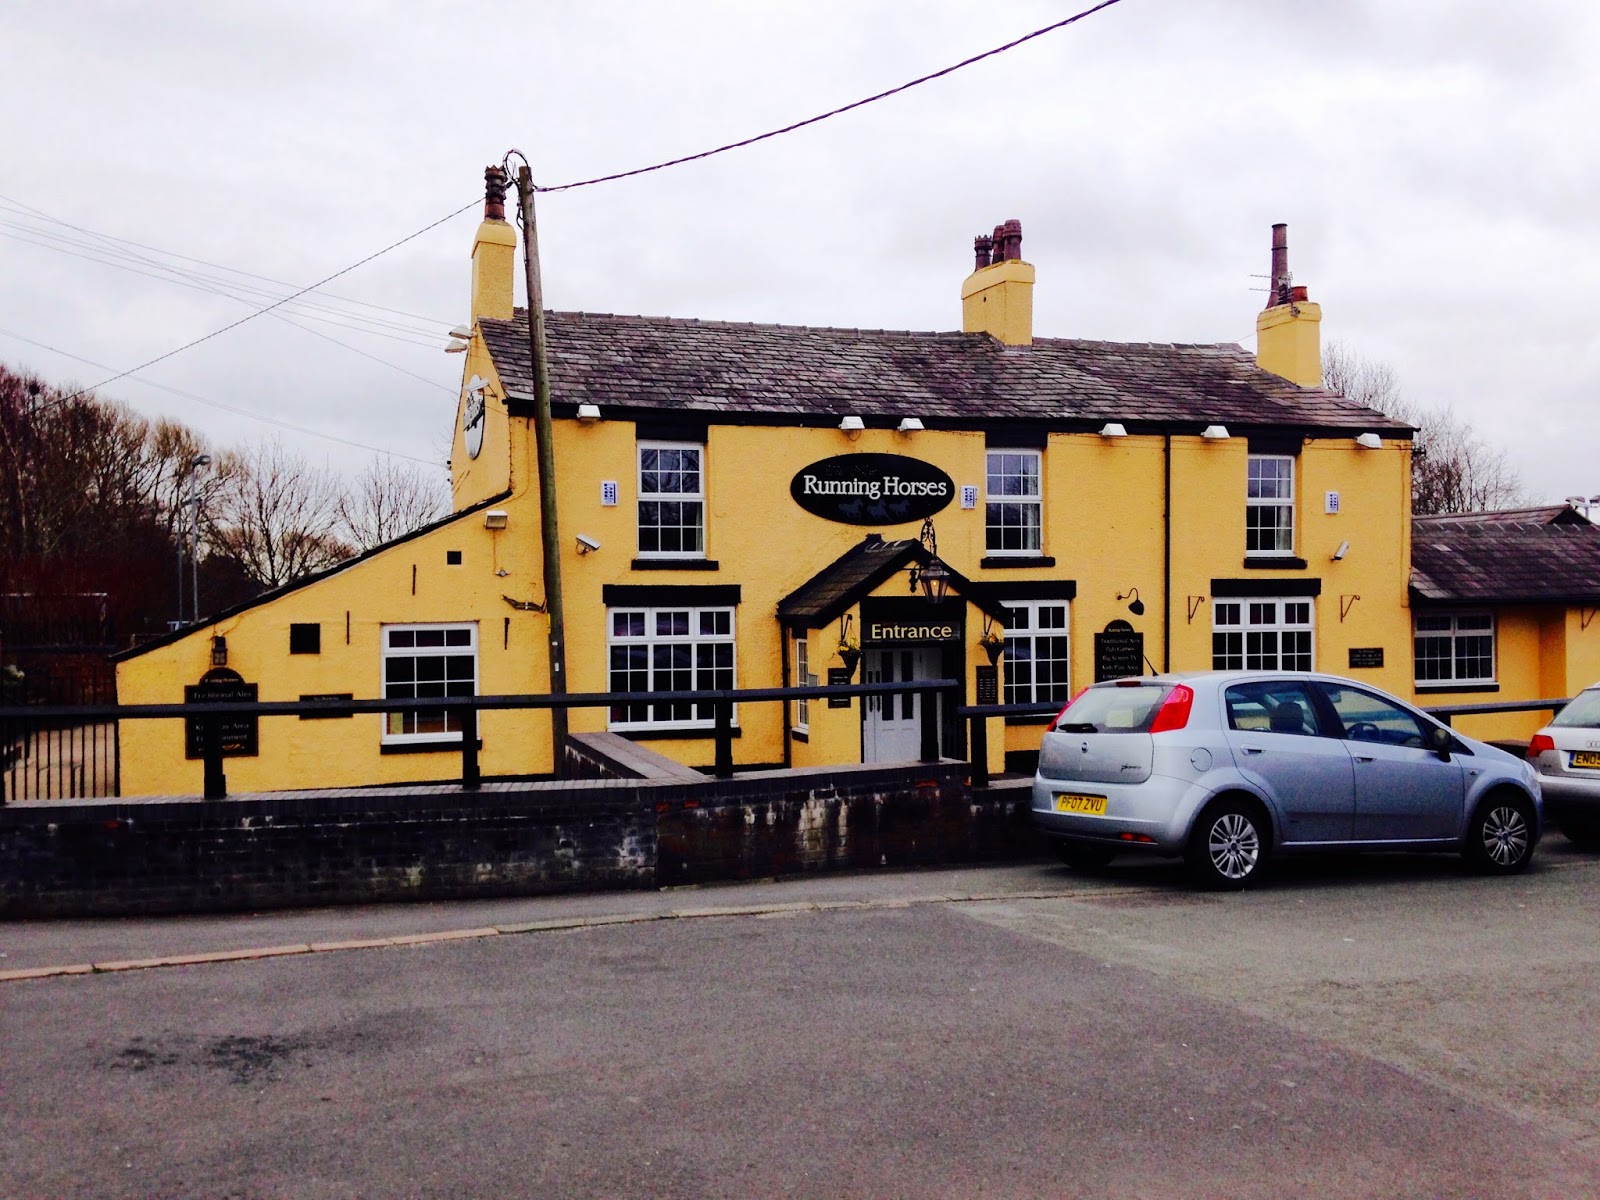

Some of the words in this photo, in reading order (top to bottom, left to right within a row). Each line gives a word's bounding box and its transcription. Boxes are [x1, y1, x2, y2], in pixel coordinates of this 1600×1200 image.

[803, 475, 880, 499] Running
[883, 476, 947, 496] Horses
[871, 623, 953, 639] Entrance
[1060, 796, 1083, 809] PF07
[1084, 798, 1103, 812] ZVU
